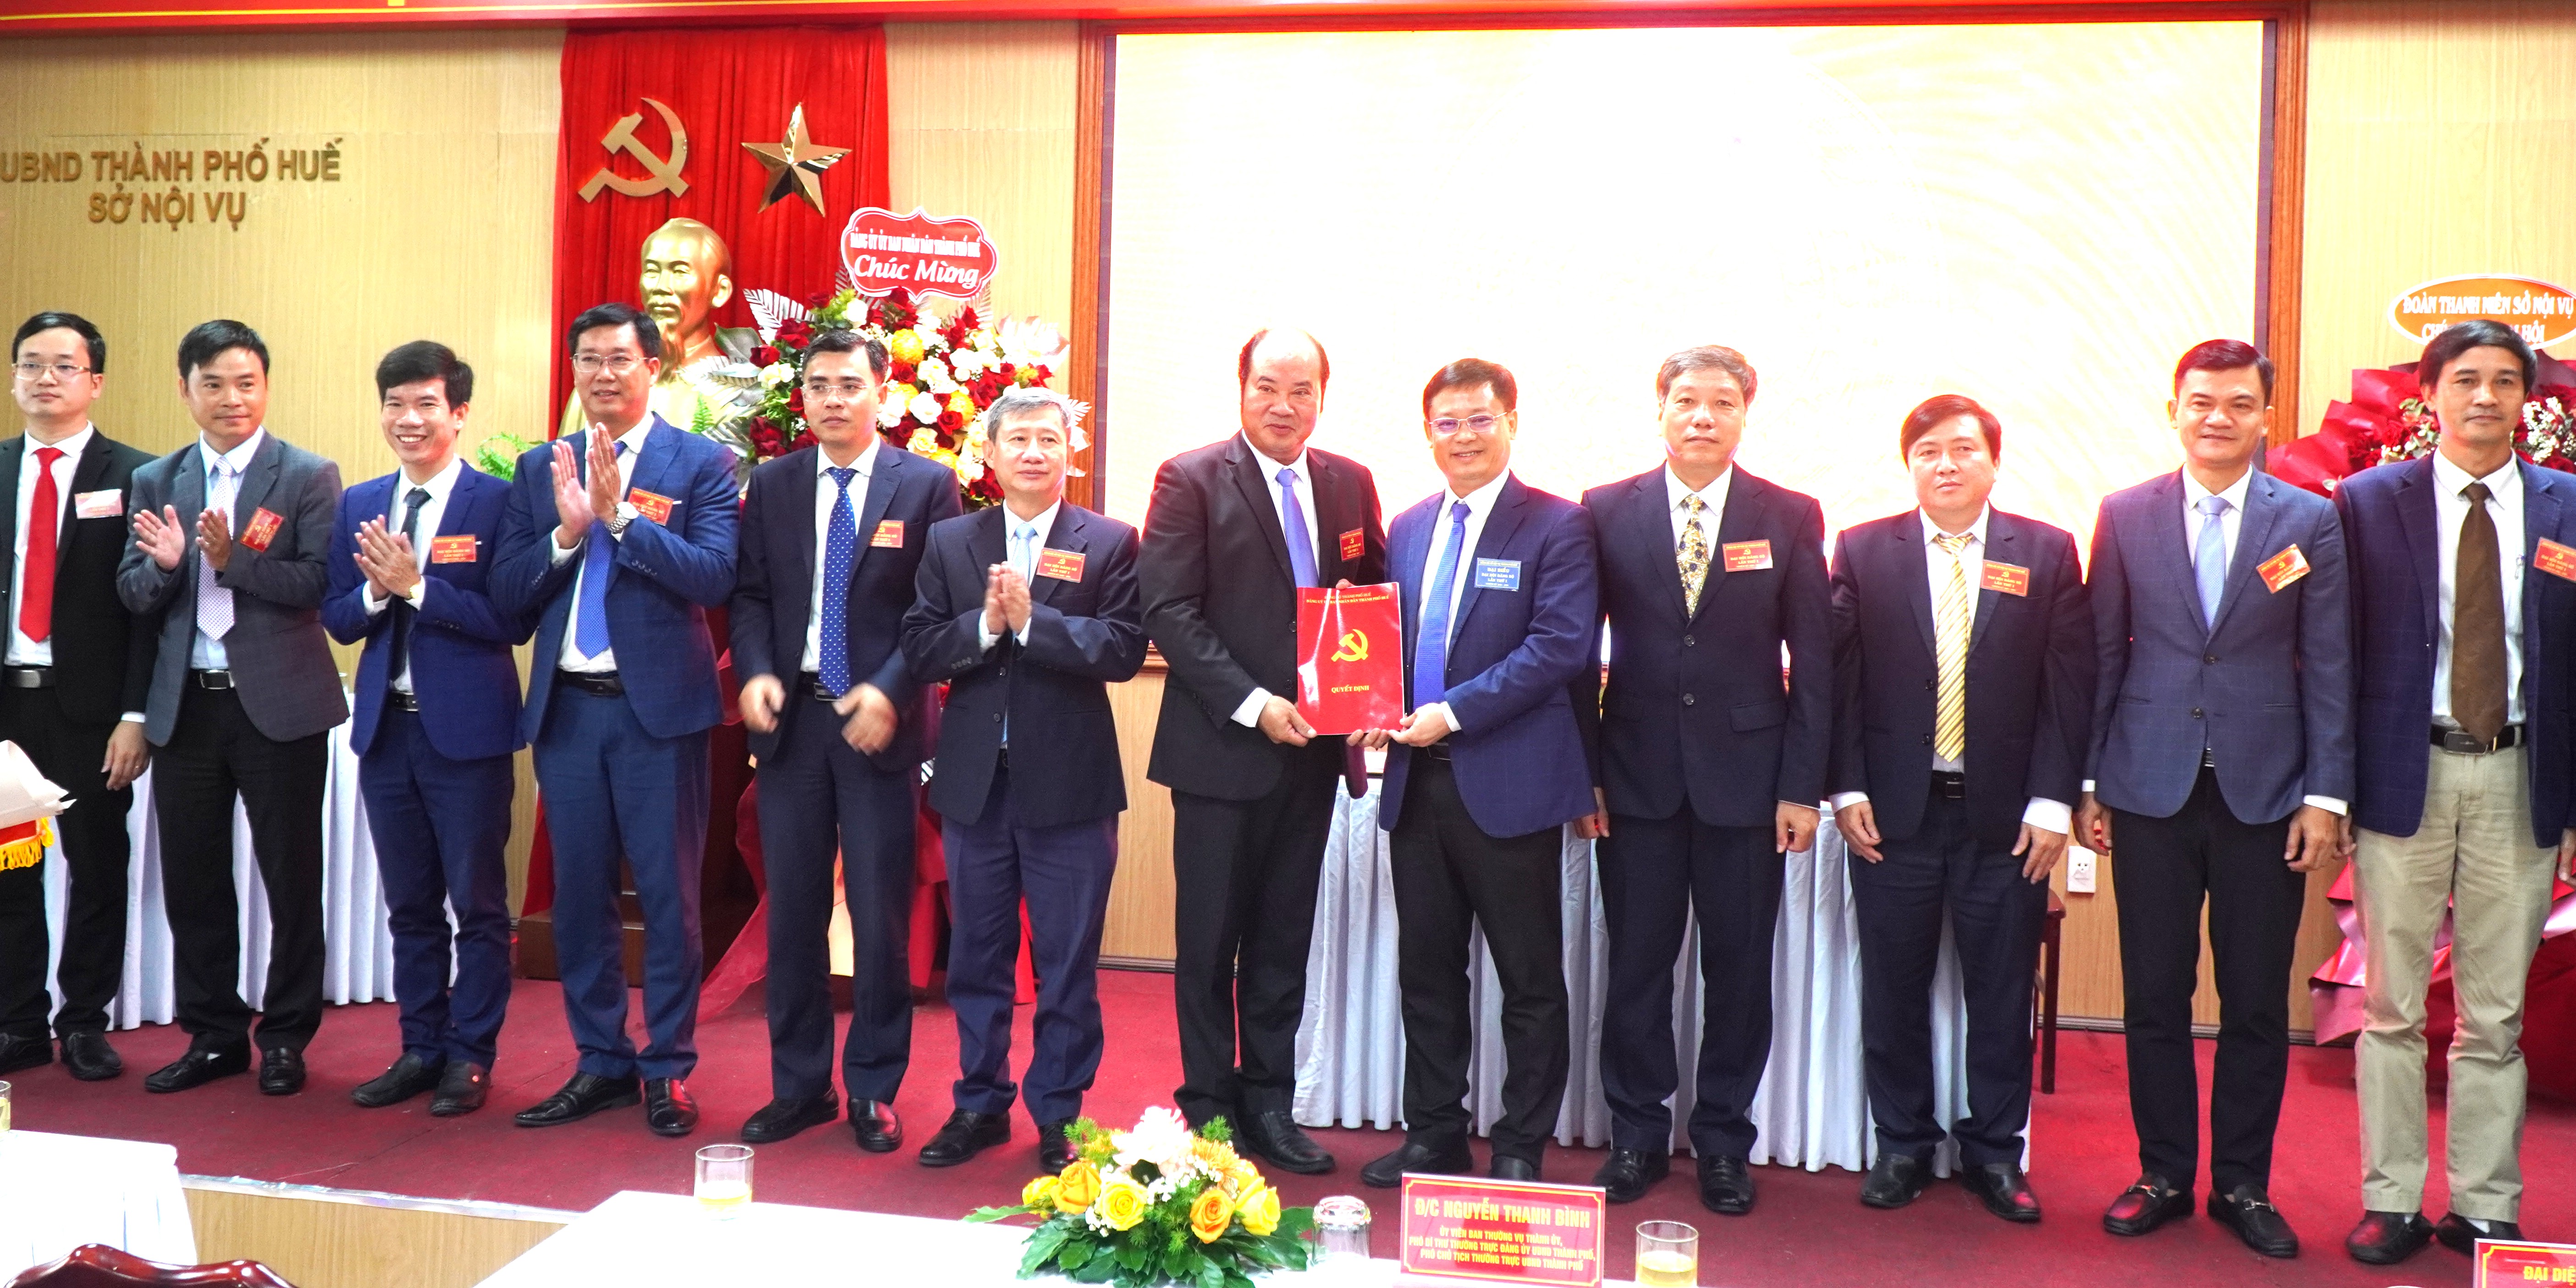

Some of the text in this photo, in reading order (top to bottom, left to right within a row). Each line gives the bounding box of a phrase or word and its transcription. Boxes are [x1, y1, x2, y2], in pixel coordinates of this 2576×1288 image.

[0, 137, 343, 182] UBND THÀNH PHỐ HUẾ
[88, 182, 246, 231] SỞ NỘI VỤ
[854, 254, 979, 290] Chúc Mừng
[2403, 290, 2574, 319] ĐOÀN THANH NIÊN SỞ NỘI VỤ
[1331, 684, 1353, 694] QUYẾT
[1415, 1197, 1590, 1228] Đ/C NGUYỄN THANH BÌNH
[1451, 1227, 1467, 1238] VIÊN
[1469, 1230, 1483, 1239] BAN
[1484, 1231, 1513, 1242] THƯỜNG
[1514, 1233, 1524, 1244] VỤ
[1526, 1233, 1549, 1244] THÀNH
[1437, 1249, 1452, 1260] CHỦ
[1453, 1252, 1470, 1263] TỊCH
[1472, 1253, 1500, 1265] THƯỜNG
[1502, 1255, 1520, 1267] TRỰC
[1522, 1257, 1541, 1268] UBND
[1543, 1258, 1567, 1270] THÀNH
[1568, 1260, 1584, 1271] PHỐ
[1450, 1239, 1478, 1251] THƯỜNG
[1480, 1242, 1498, 1254] TRỰC
[1500, 1242, 1519, 1254] ĐẢNG
[1521, 1244, 1530, 1255] ỦY
[1532, 1246, 1552, 1257] UBND
[1553, 1247, 1577, 1259] THÀNH
[2523, 1266, 2576, 1286] ĐẠI DIỆ
